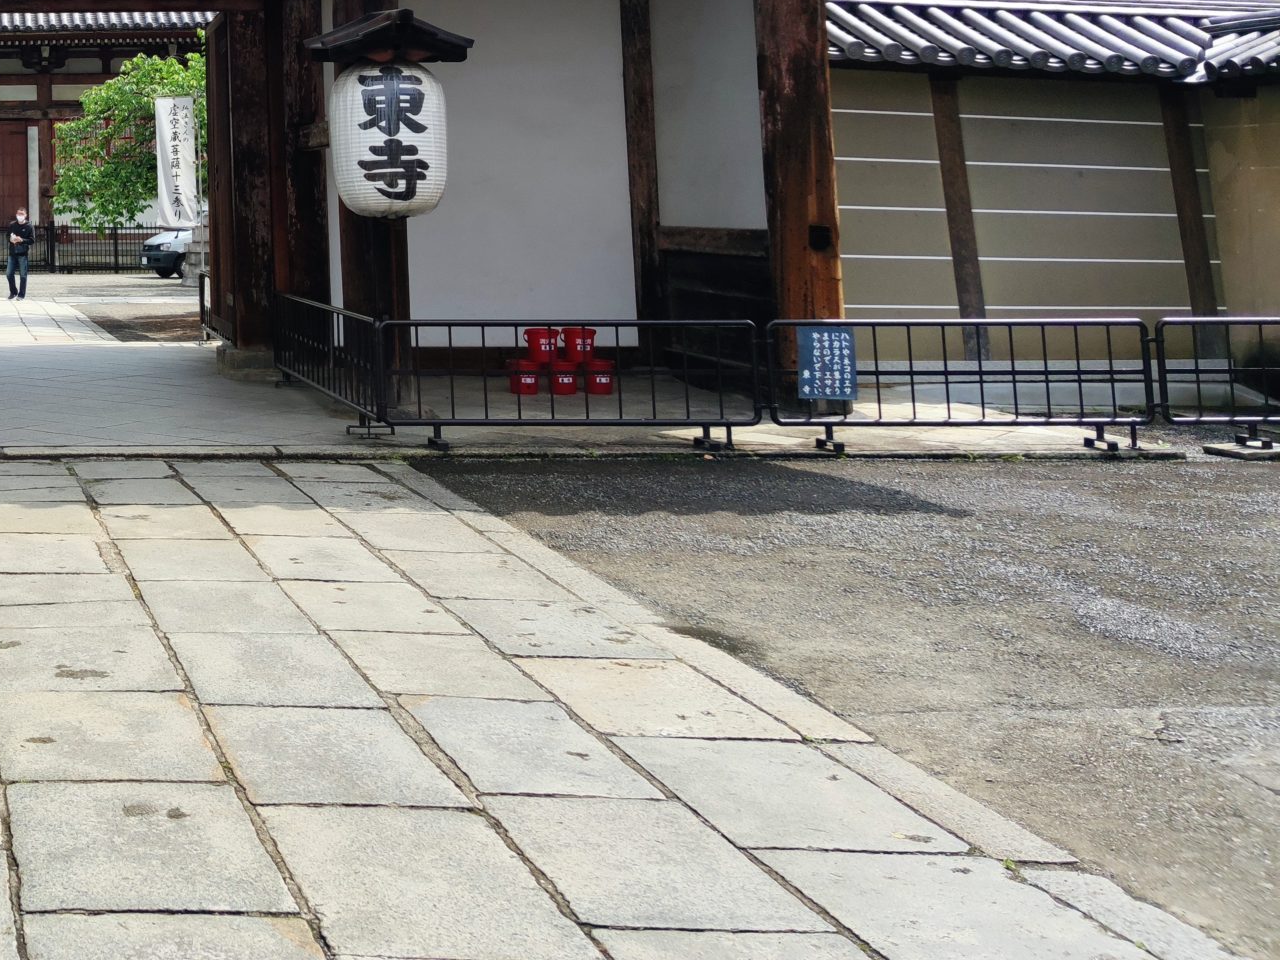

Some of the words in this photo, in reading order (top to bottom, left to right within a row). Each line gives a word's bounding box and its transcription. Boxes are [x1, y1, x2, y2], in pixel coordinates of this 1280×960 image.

[168, 103, 184, 223] 虚空蔵菩薩十三参り
[357, 66, 430, 201] 東寺
[802, 369, 811, 394] 東寺
[822, 332, 832, 395] ますので、エサを
[832, 332, 841, 394] にカラスが集まり
[841, 332, 852, 394] ハトやネコのエサ
